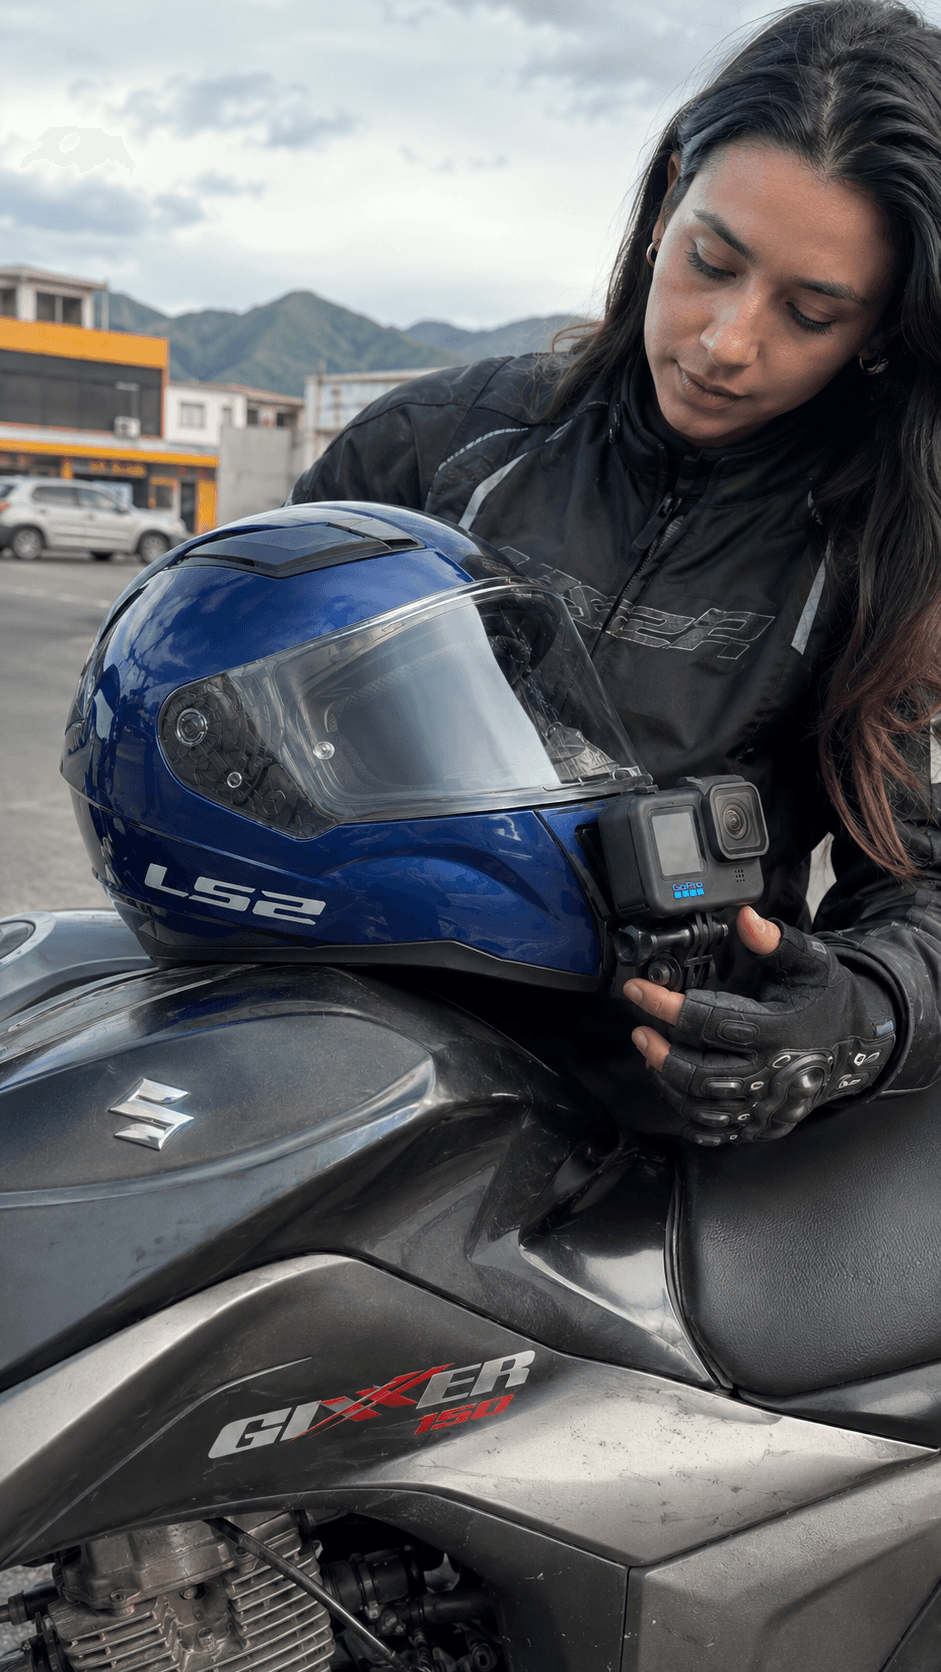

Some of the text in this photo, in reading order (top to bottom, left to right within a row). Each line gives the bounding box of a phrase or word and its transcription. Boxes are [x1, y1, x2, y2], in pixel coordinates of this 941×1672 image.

[144, 863, 326, 926] LS2
[672, 881, 703, 891] GoPro
[414, 1393, 515, 1435] 150
